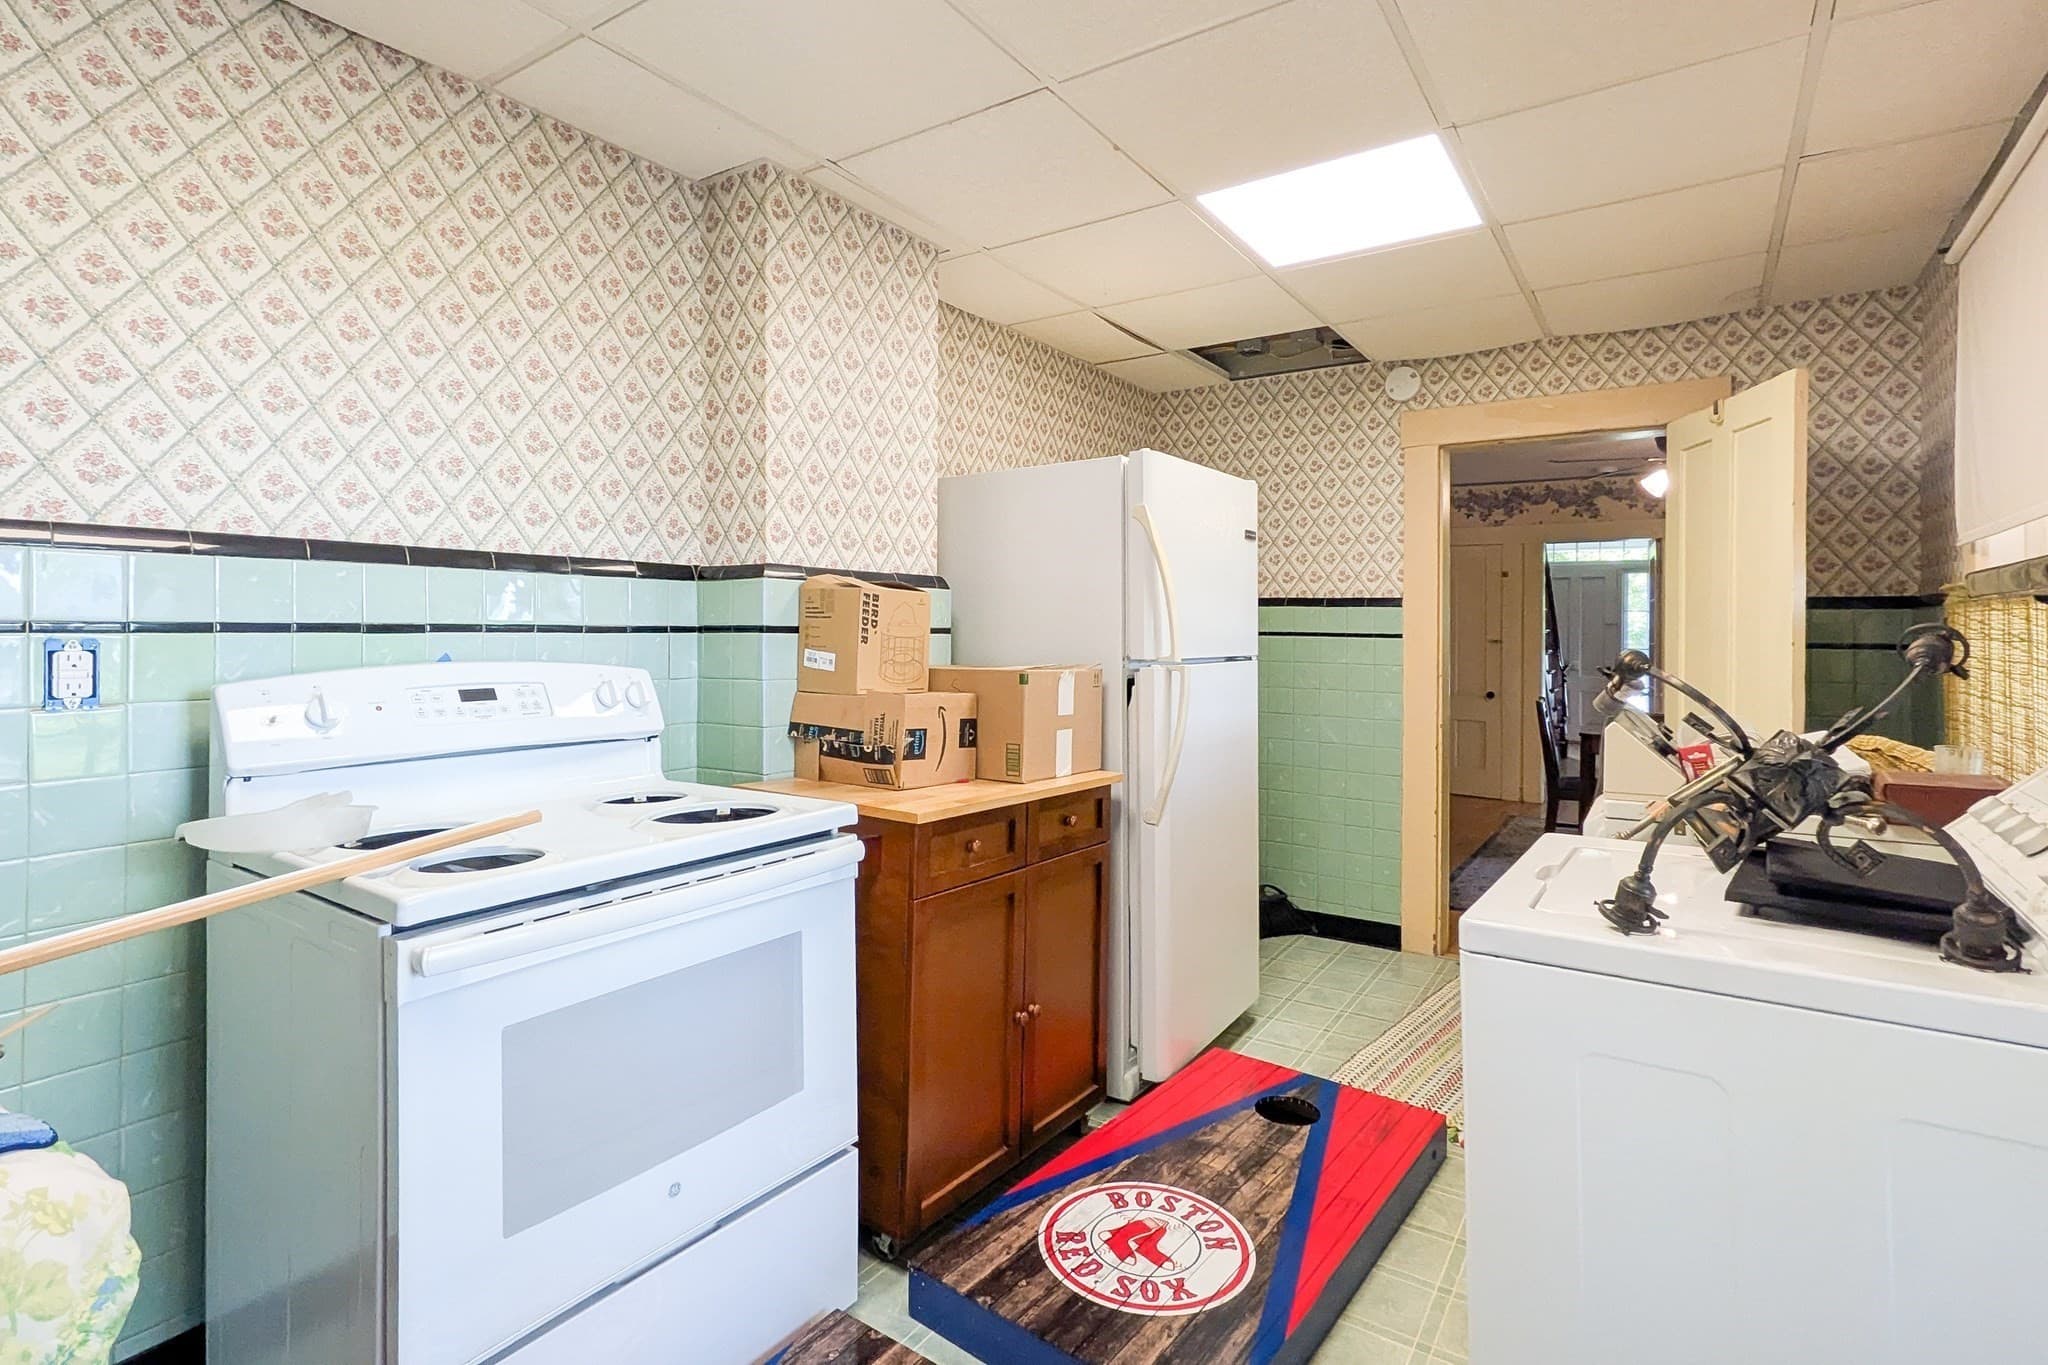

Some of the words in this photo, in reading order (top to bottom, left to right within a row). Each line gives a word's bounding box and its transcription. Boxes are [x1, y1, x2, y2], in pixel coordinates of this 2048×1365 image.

[860, 592, 871, 645] FEEDER
[870, 593, 880, 632] BIRD
[1106, 1191, 1238, 1251] BOSTON
[1056, 1231, 1103, 1278] RED
[1110, 1275, 1199, 1303] SOX
